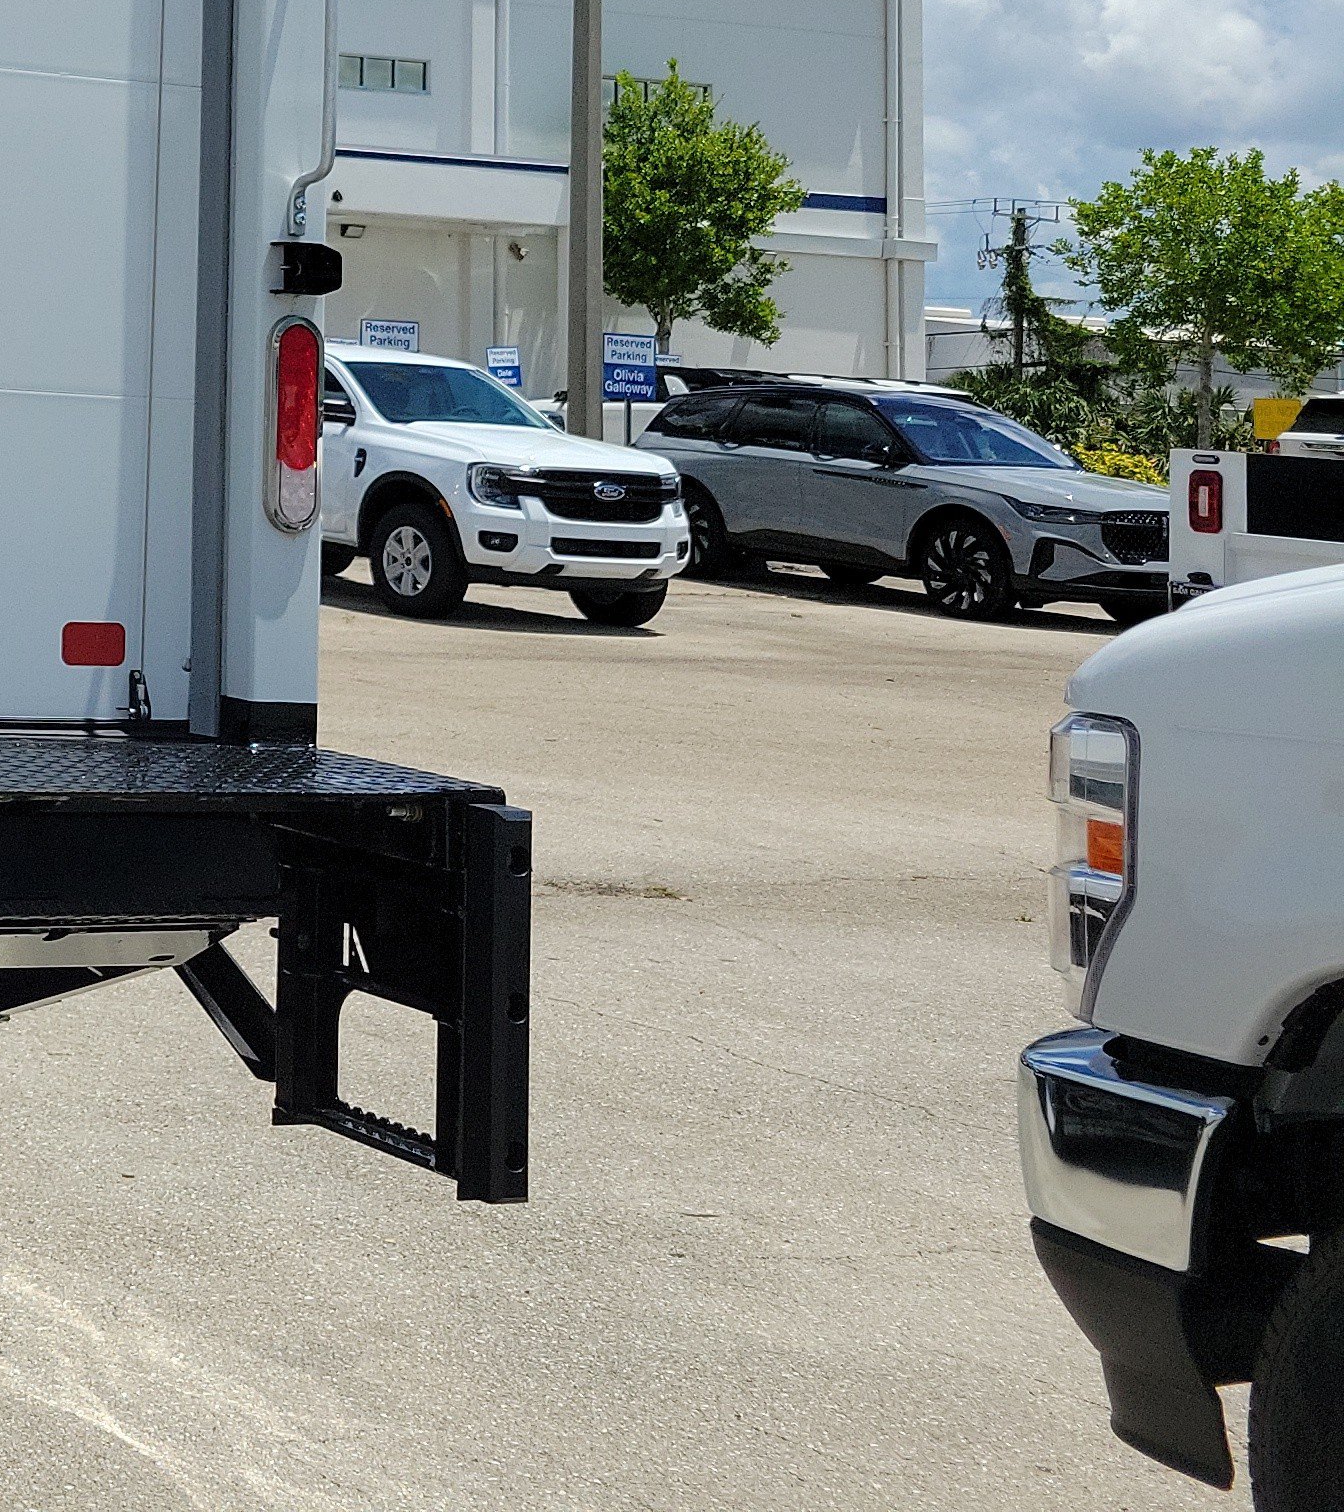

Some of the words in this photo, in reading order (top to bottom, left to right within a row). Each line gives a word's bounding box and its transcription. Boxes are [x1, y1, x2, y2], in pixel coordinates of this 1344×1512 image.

[365, 322, 415, 336] Reserved
[370, 335, 411, 350] Parking
[607, 337, 652, 349] Reserved
[610, 350, 647, 363] Parking
[613, 369, 645, 382] Olivia
[604, 380, 654, 397] Galloway
